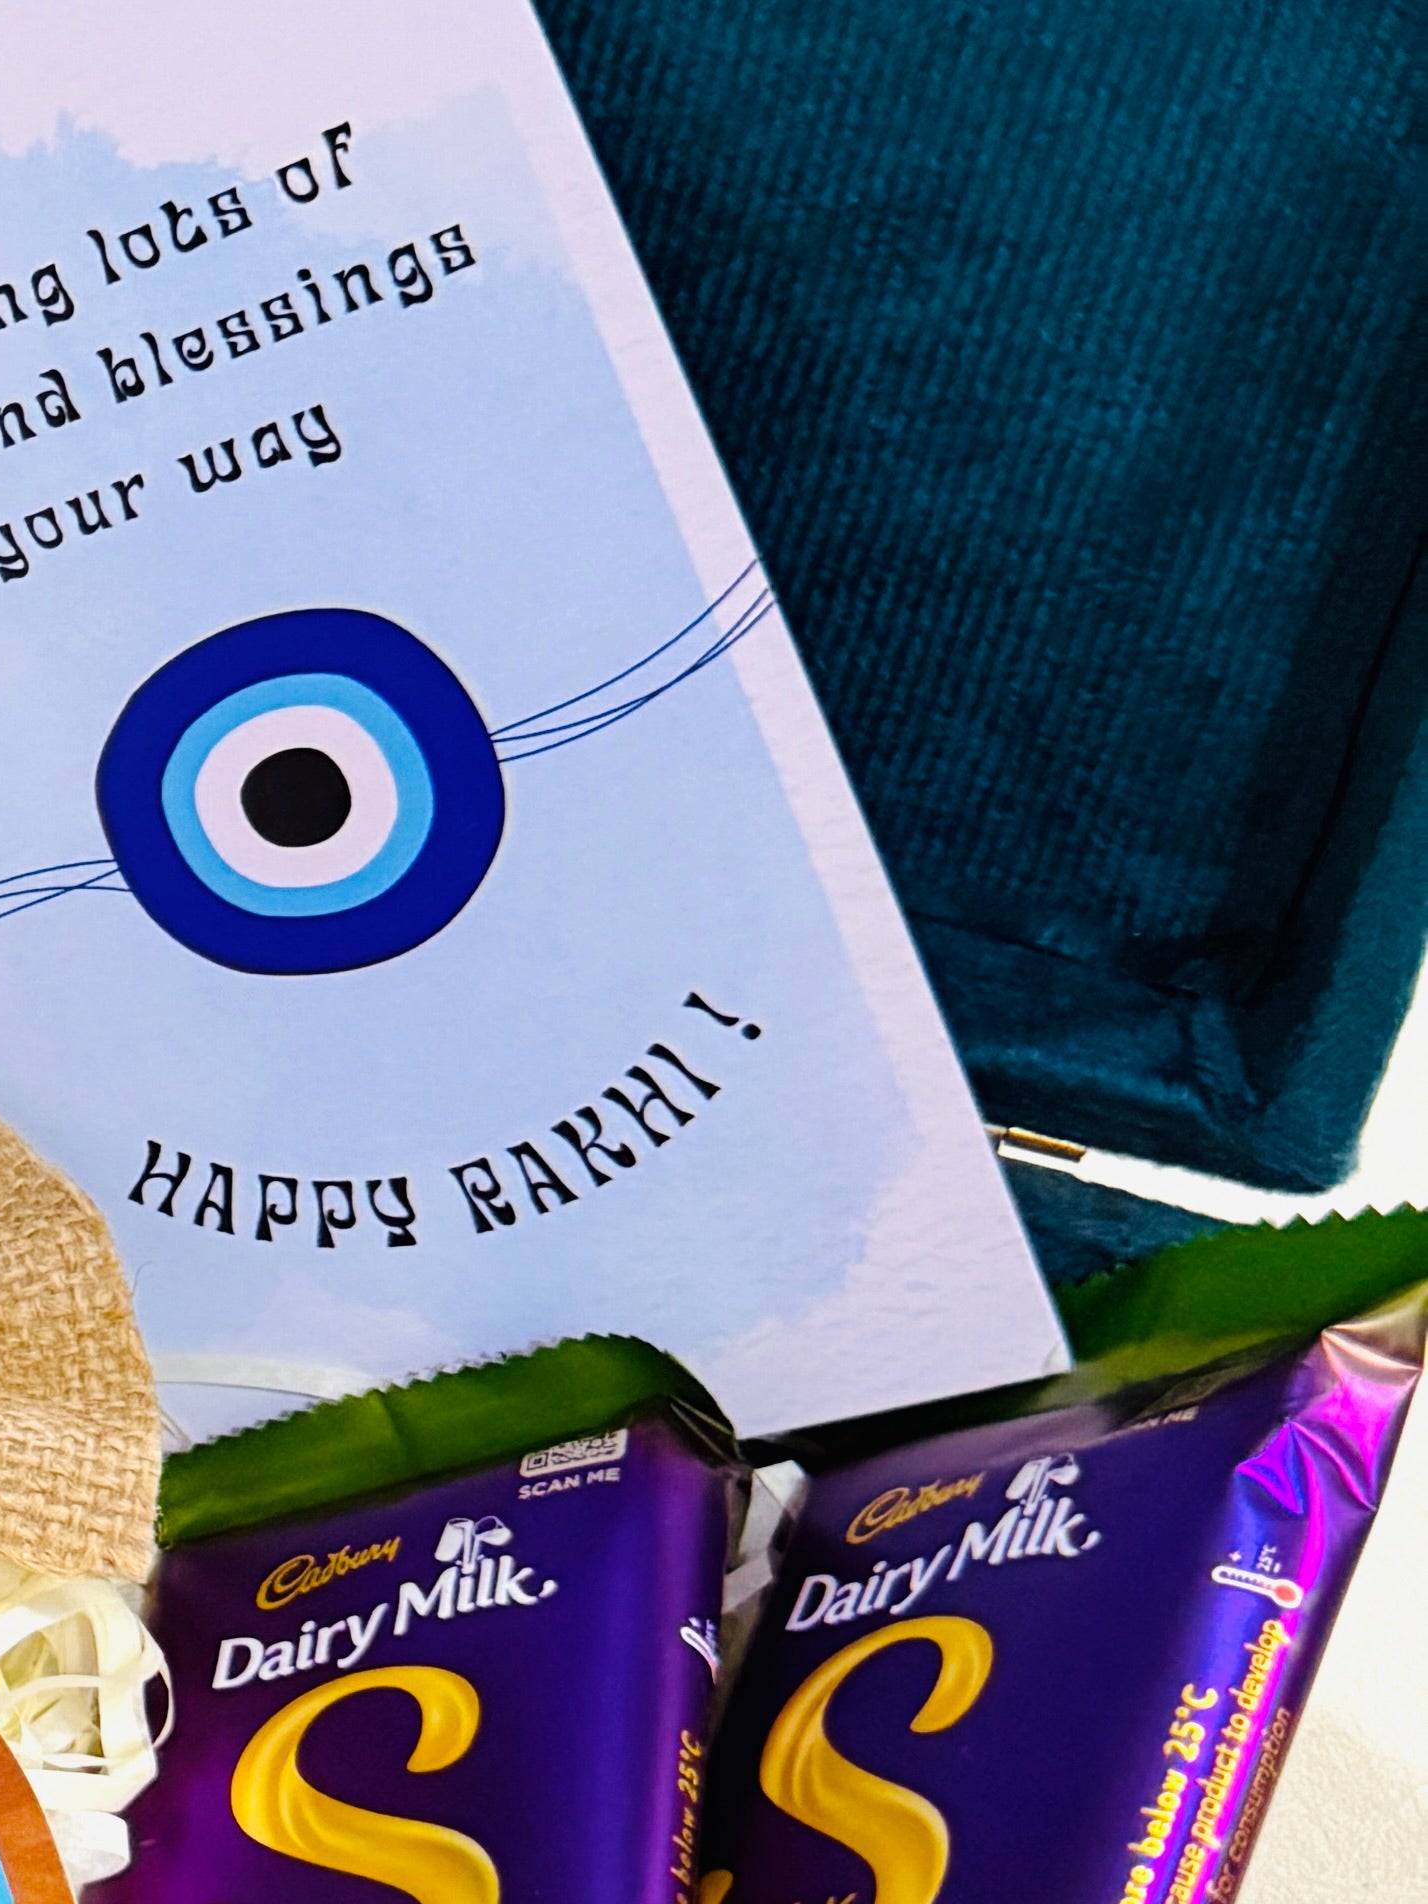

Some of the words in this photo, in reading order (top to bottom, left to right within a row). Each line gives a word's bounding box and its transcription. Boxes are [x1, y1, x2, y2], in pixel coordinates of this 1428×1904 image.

[87, 187, 253, 285] lots
[98, 224, 477, 404] blessings
[179, 403, 343, 494] way
[127, 1139, 418, 1249] HAPPY
[517, 1473, 581, 1500] SCAN
[586, 1467, 621, 1484] ME
[845, 1471, 987, 1544] Cadbury
[255, 1536, 401, 1610] Cadbury
[785, 1544, 952, 1631] Dairy
[945, 1497, 1086, 1581] Milk
[211, 1602, 389, 1690] Dairy
[393, 1555, 539, 1636] Milk
[1223, 1616, 1297, 1711] develop
[675, 1729, 704, 1801] 25°C
[1128, 1768, 1189, 1860] below
[1161, 1678, 1220, 1766] 25°C
[1217, 1710, 1250, 1742] to
[1187, 1738, 1240, 1847] product
[1199, 1861, 1236, 1904] for
[1222, 1704, 1292, 1862] consumption
